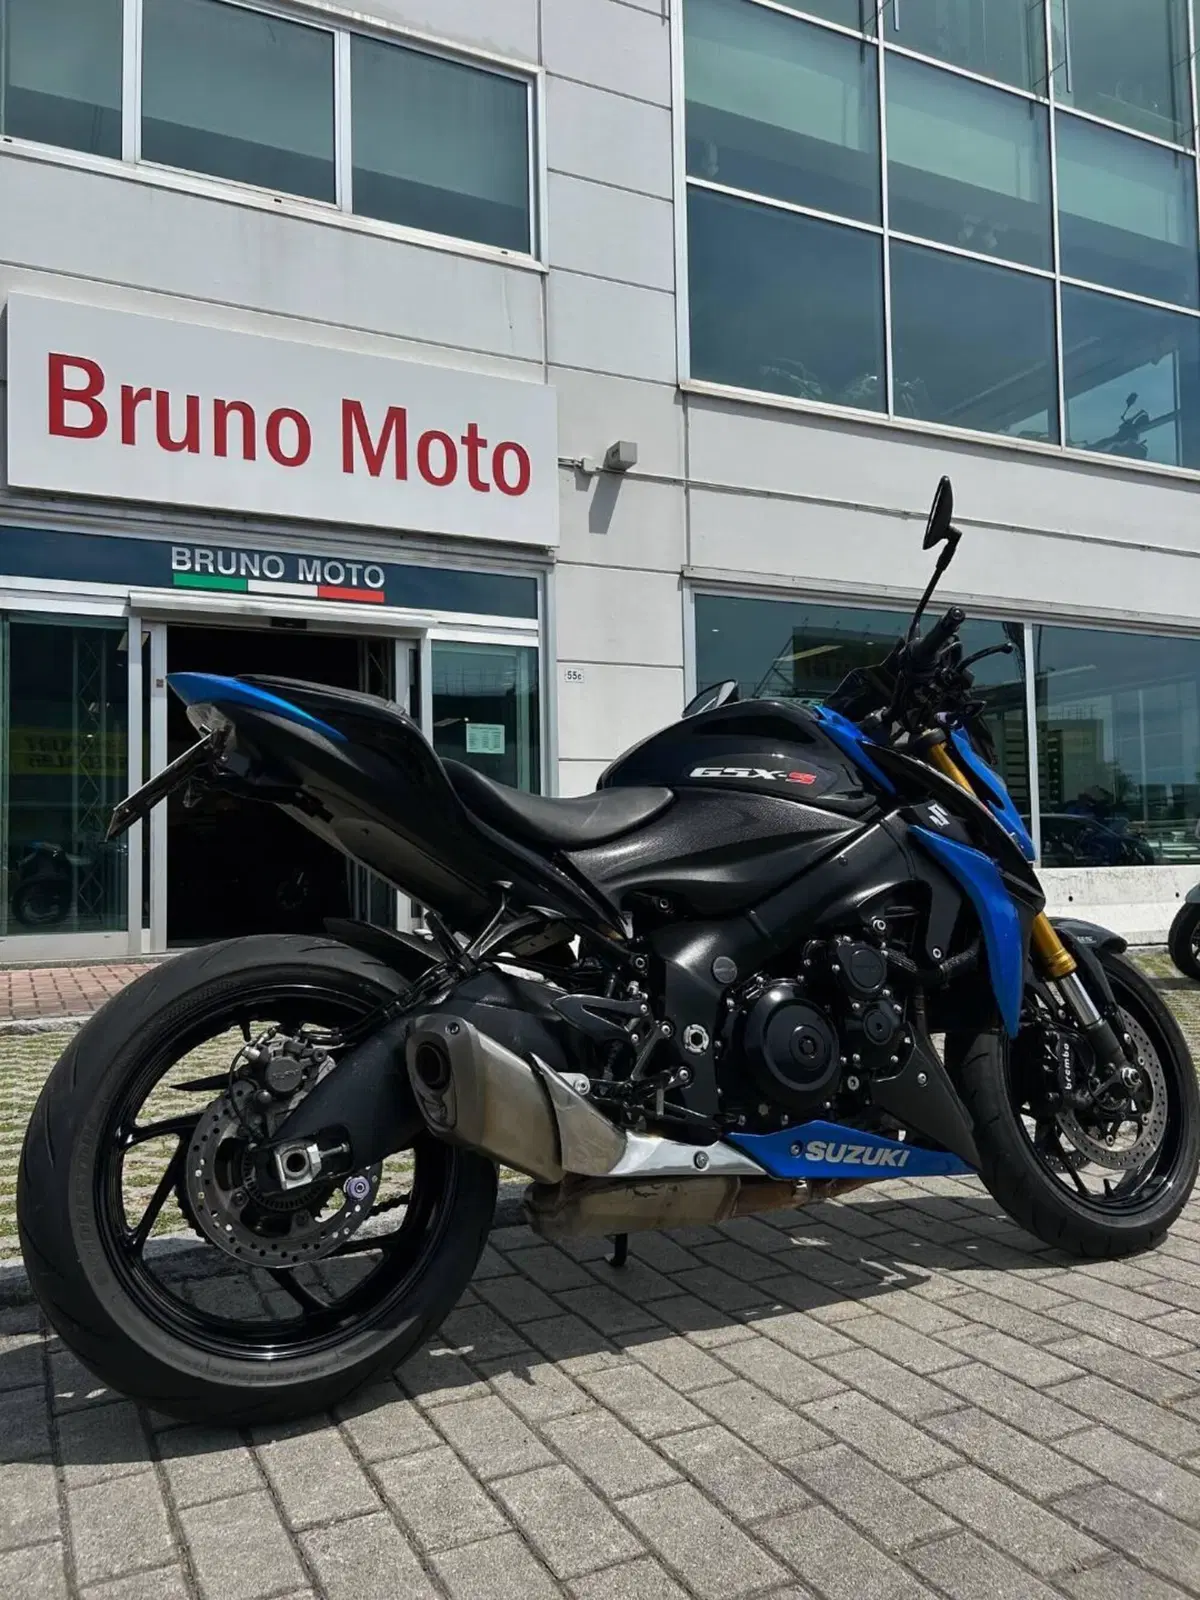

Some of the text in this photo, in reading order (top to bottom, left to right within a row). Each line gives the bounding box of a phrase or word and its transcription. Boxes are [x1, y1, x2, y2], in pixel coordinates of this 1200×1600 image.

[48, 352, 531, 496] Bruno Moto
[171, 546, 385, 588] BRUNO MOTO
[690, 767, 817, 785] GSX-S
[1062, 1042, 1072, 1090] brembo
[805, 1141, 910, 1167] SUZUKI
